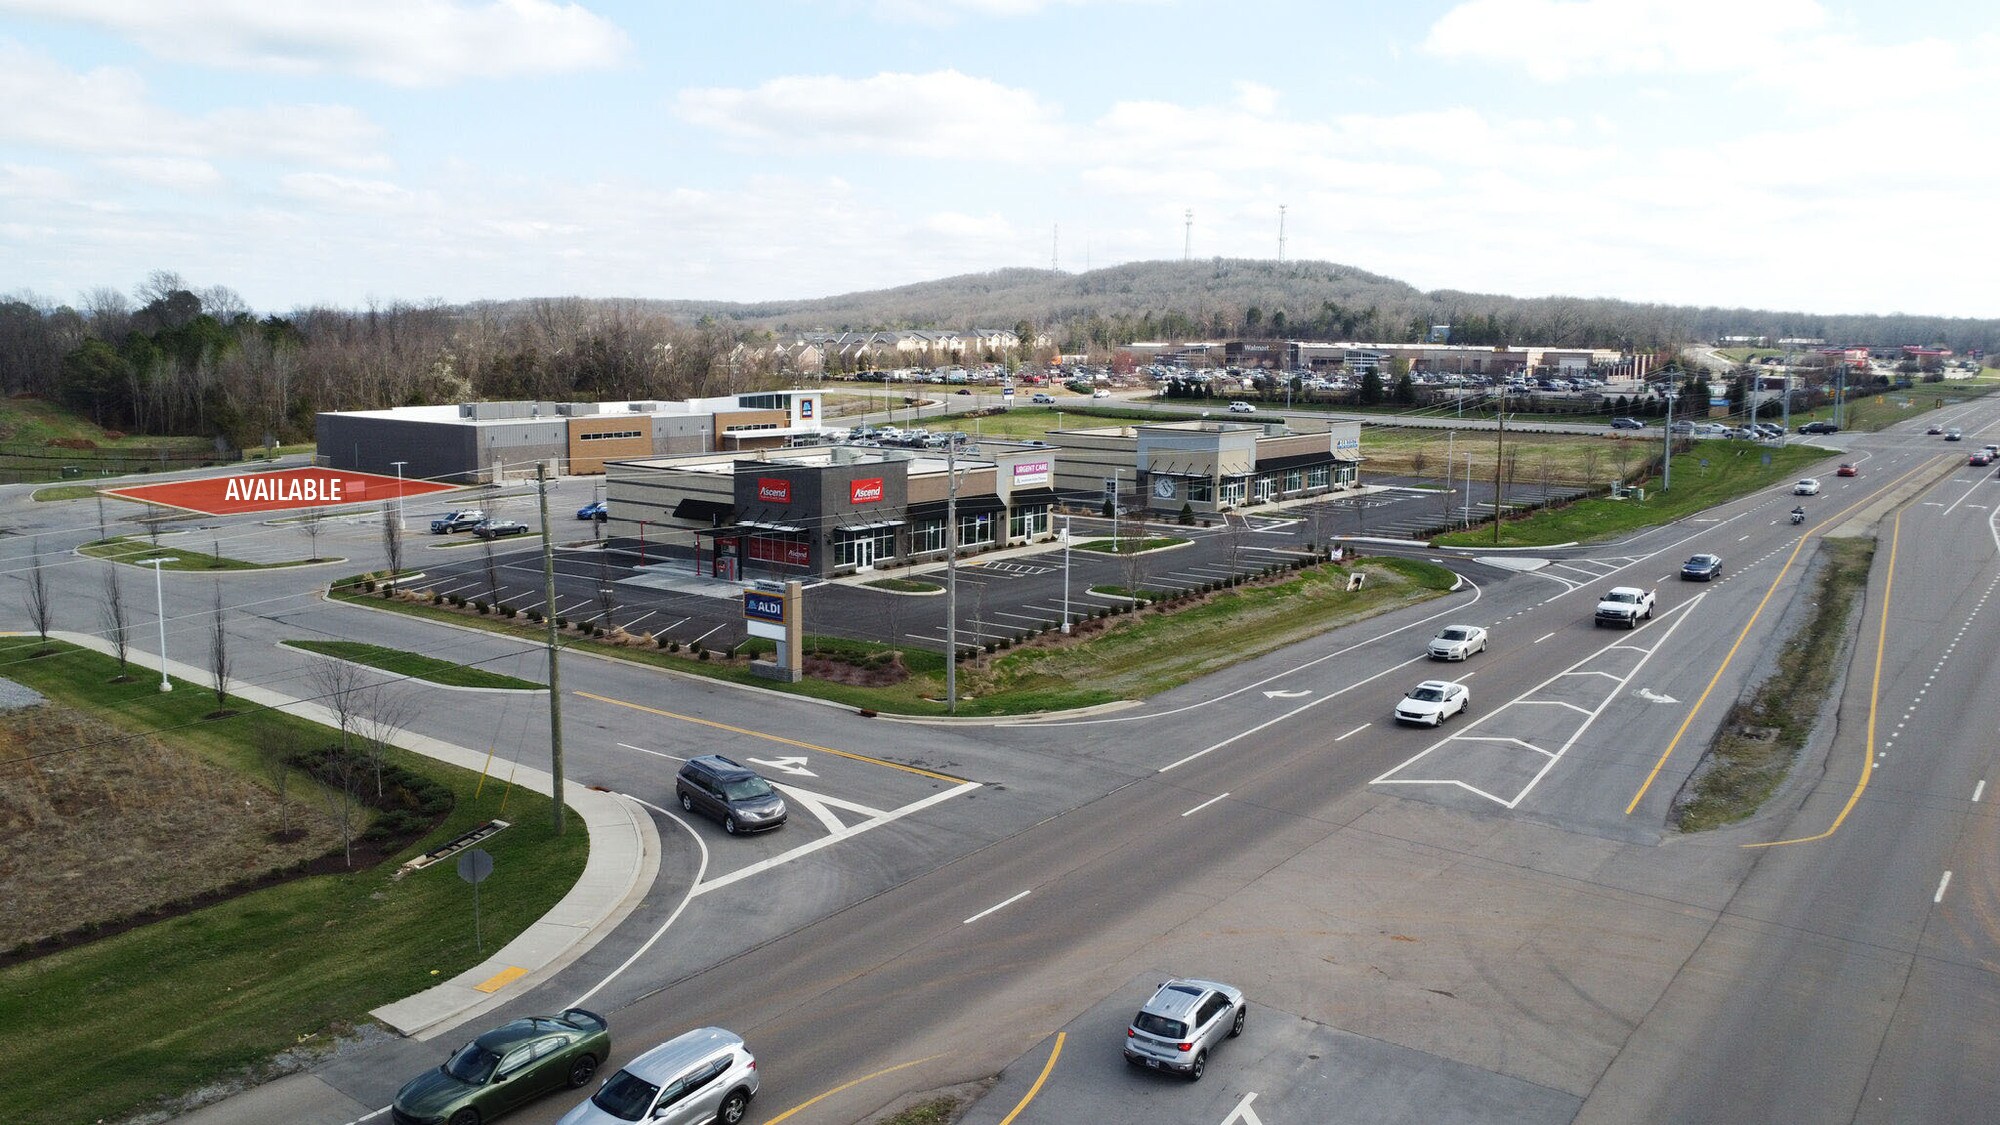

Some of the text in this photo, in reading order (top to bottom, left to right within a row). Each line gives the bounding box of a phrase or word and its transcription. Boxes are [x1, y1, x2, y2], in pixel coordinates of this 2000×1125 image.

[1016, 463, 1048, 473] URGENT CARE
[760, 486, 786, 498] Ascend
[855, 486, 881, 498] Ascend
[758, 601, 780, 614] ALDI
